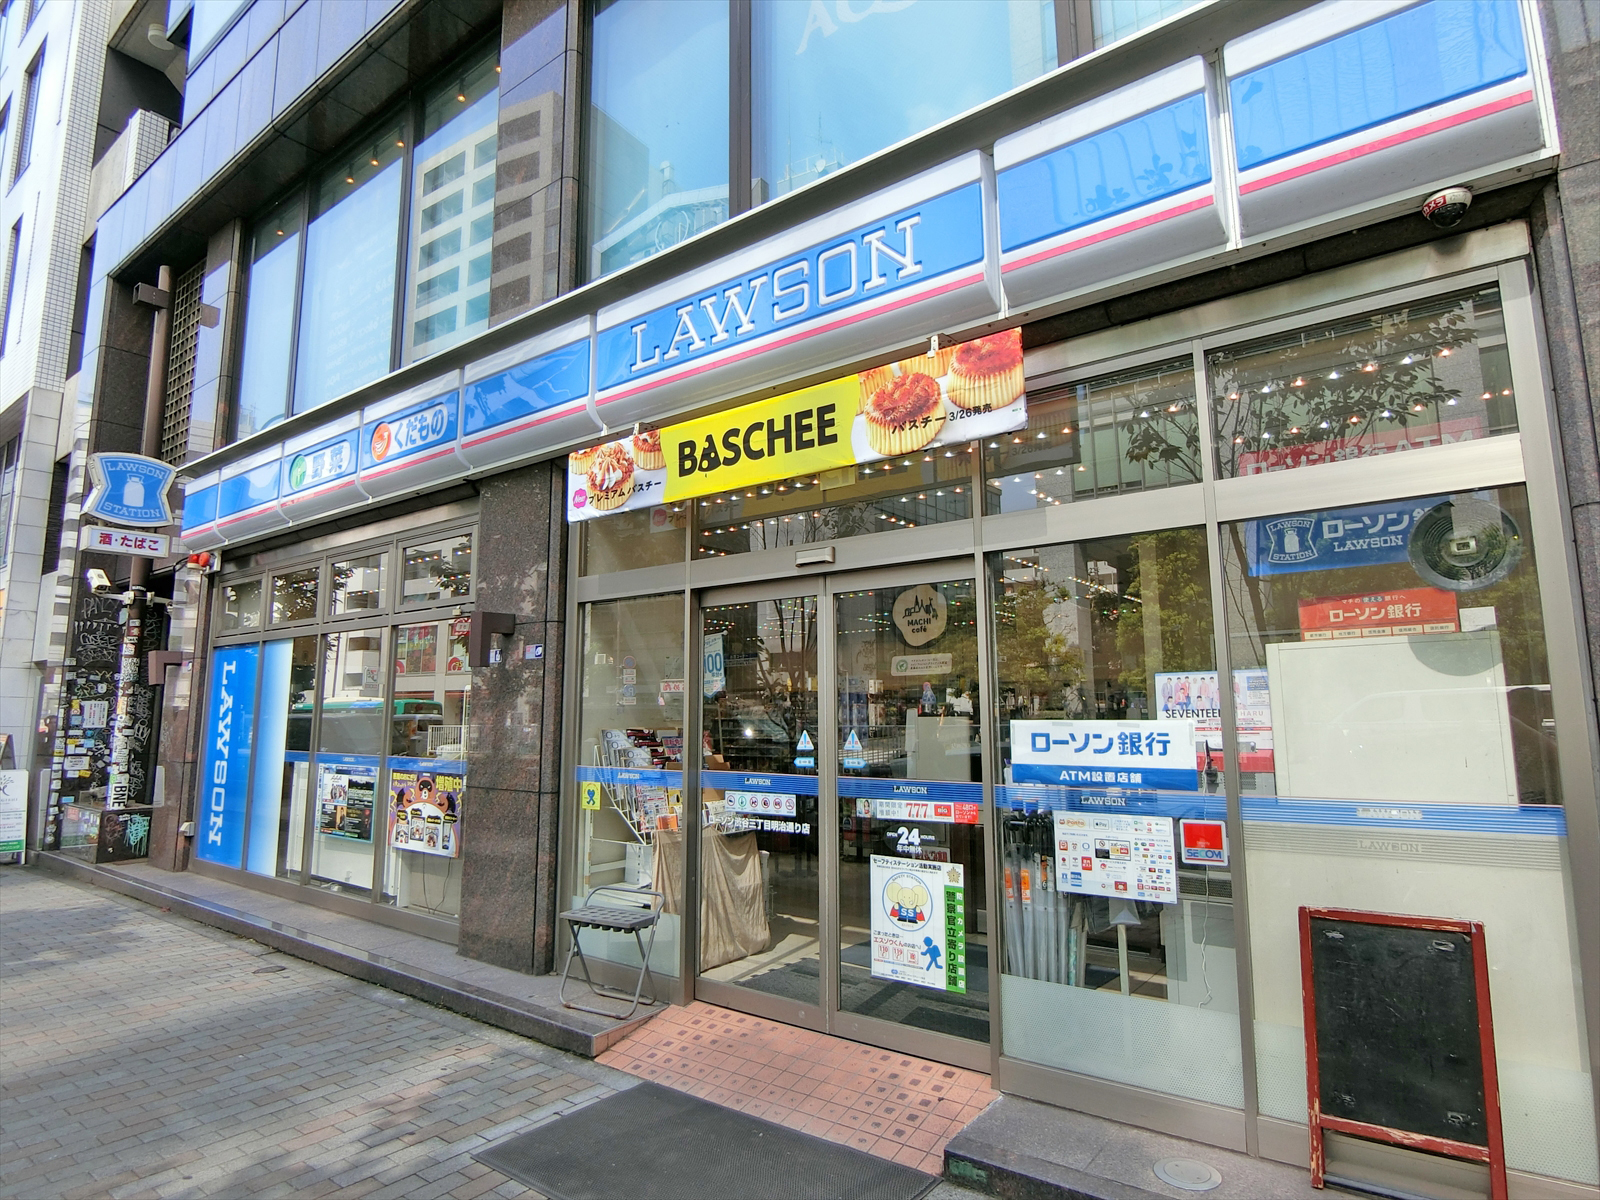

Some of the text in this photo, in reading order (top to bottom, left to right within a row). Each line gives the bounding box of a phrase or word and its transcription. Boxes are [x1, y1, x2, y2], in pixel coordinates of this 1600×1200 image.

[630, 213, 923, 373] LAWSON
[891, 403, 992, 434] バスチー 3/26発売
[393, 408, 448, 449] くだもの
[678, 403, 838, 478] BASCHEE
[106, 461, 165, 479] LAWSON
[310, 444, 345, 479] 野菜
[103, 501, 161, 518] STATION
[1270, 519, 1311, 532] LAWSON
[1334, 535, 1403, 552] LAWSON
[1273, 550, 1313, 561] STATION
[1329, 602, 1422, 623] ローソン銀行
[907, 618, 931, 626] MACHI
[1165, 709, 1221, 718] SEVENTEE
[1030, 731, 1171, 757] ローソン銀行
[208, 660, 236, 846] LAWSON
[744, 777, 771, 785] LAWSON
[1059, 770, 1142, 784] ATM設置店舗
[111, 785, 127, 808] BNE
[893, 785, 928, 795] LAWSON
[1080, 796, 1126, 806] LAWSON
[897, 826, 920, 846] 24
[1186, 849, 1222, 859] SECOM
[1359, 840, 1420, 852] LAWSON
[900, 908, 914, 917] SS
[946, 891, 957, 986] 警察官立寄り店舗
